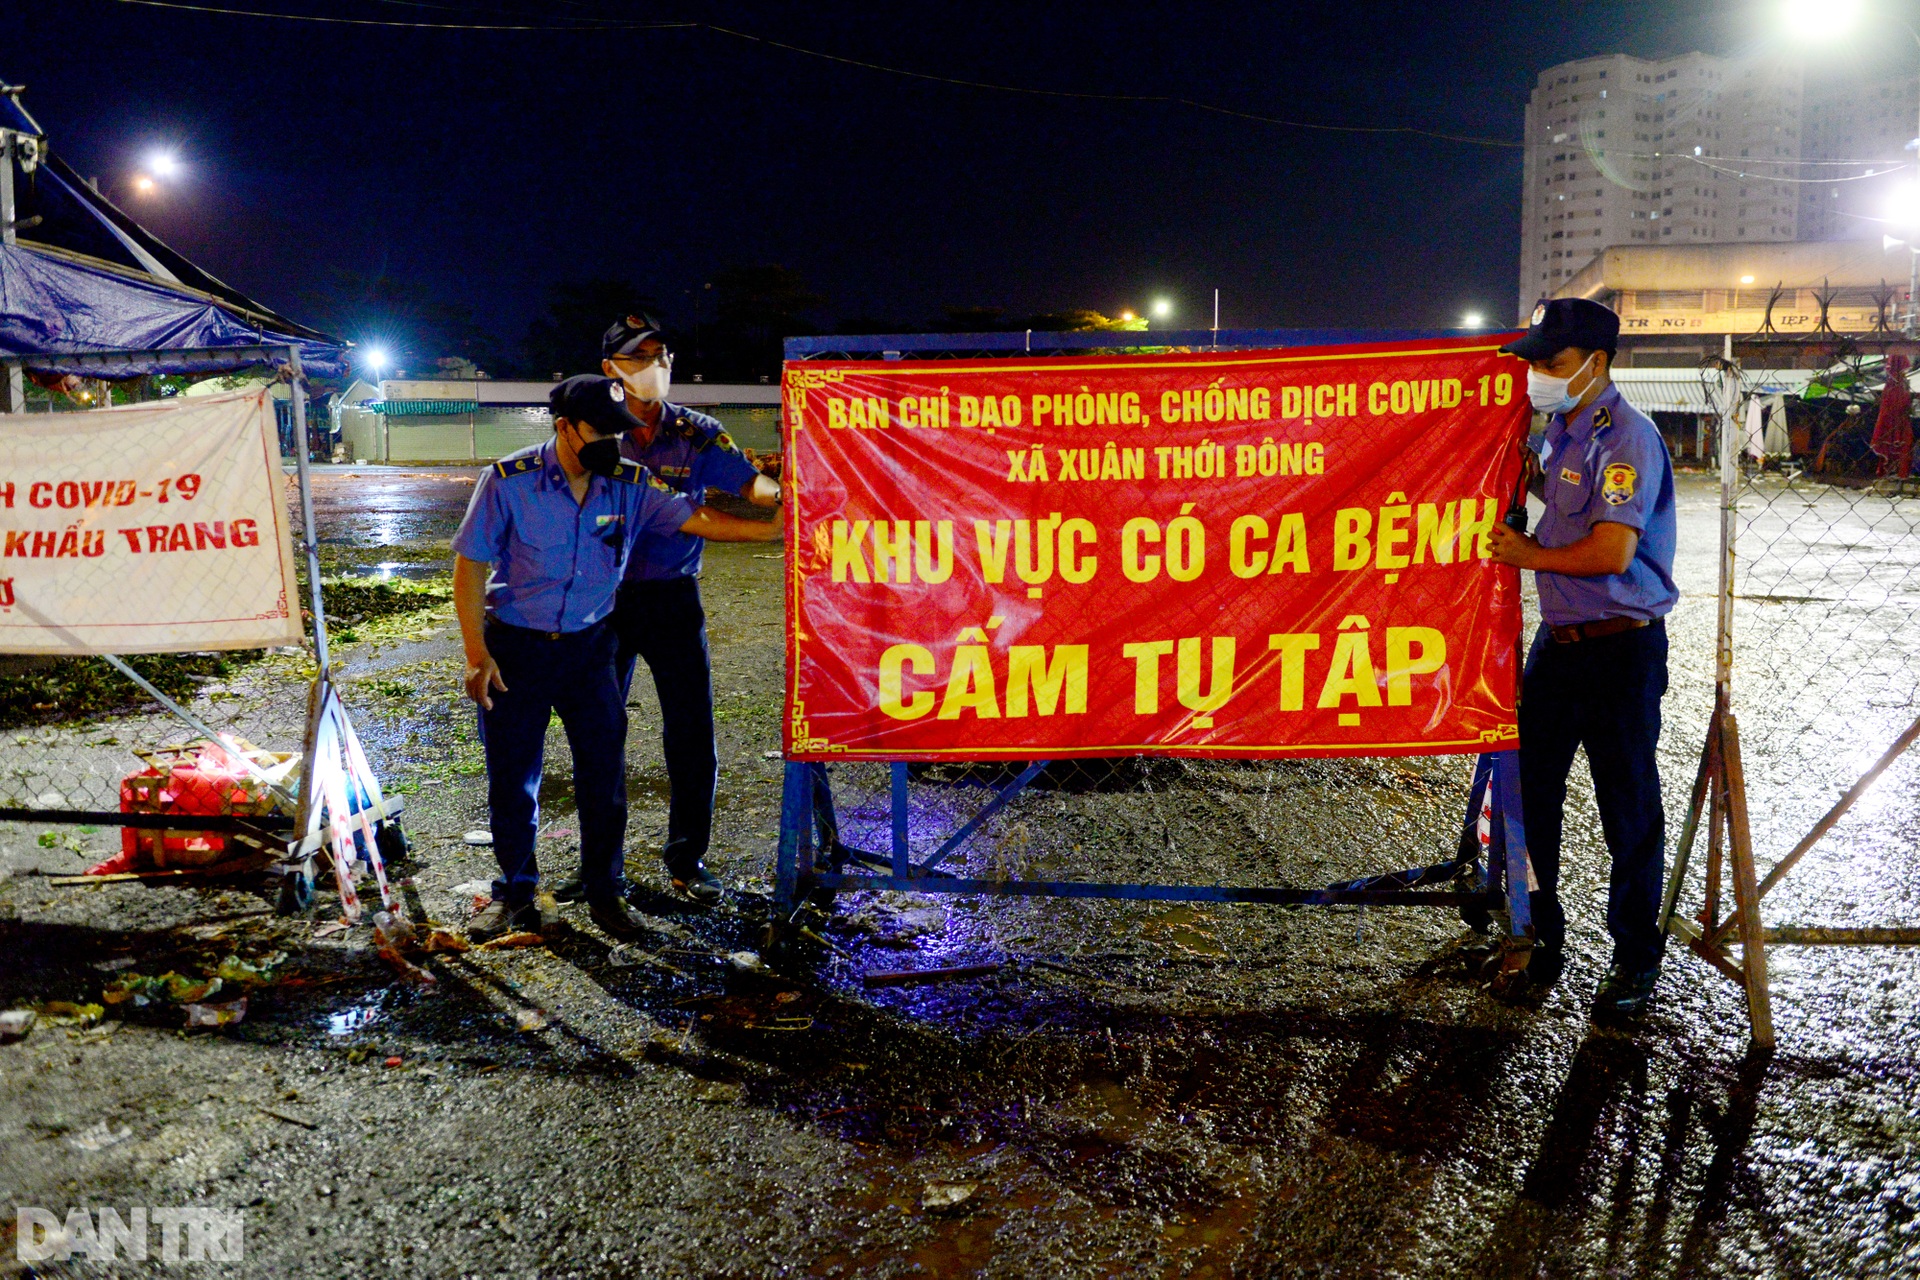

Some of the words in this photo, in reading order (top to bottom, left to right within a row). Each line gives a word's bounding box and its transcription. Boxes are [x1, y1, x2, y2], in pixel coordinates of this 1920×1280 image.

[828, 397, 890, 429] BAN
[900, 386, 949, 428] CHỈ
[960, 395, 1022, 434] ĐẠO
[1033, 385, 1150, 428] PHÒNG,
[1161, 377, 1270, 423] CHỐNG
[1282, 383, 1356, 425] DỊCH
[1368, 373, 1513, 416] COVID-19
[1008, 441, 1048, 482] XÃ
[1058, 442, 1144, 481] XUÂN
[1154, 439, 1225, 478] THỚI
[1236, 437, 1325, 476] ĐÔNG
[29, 474, 201, 509] COVID-19
[4, 519, 104, 558] KHẨU
[118, 519, 259, 553] TRANG
[831, 520, 953, 584] KHU
[975, 512, 1098, 598] VỰC
[1121, 503, 1206, 583] CÓ
[1229, 513, 1311, 578] CA
[1333, 492, 1499, 584] BỆNH
[879, 616, 1089, 720] CẤM
[1123, 637, 1236, 729] TỤ
[1269, 615, 1447, 726] TẬP
